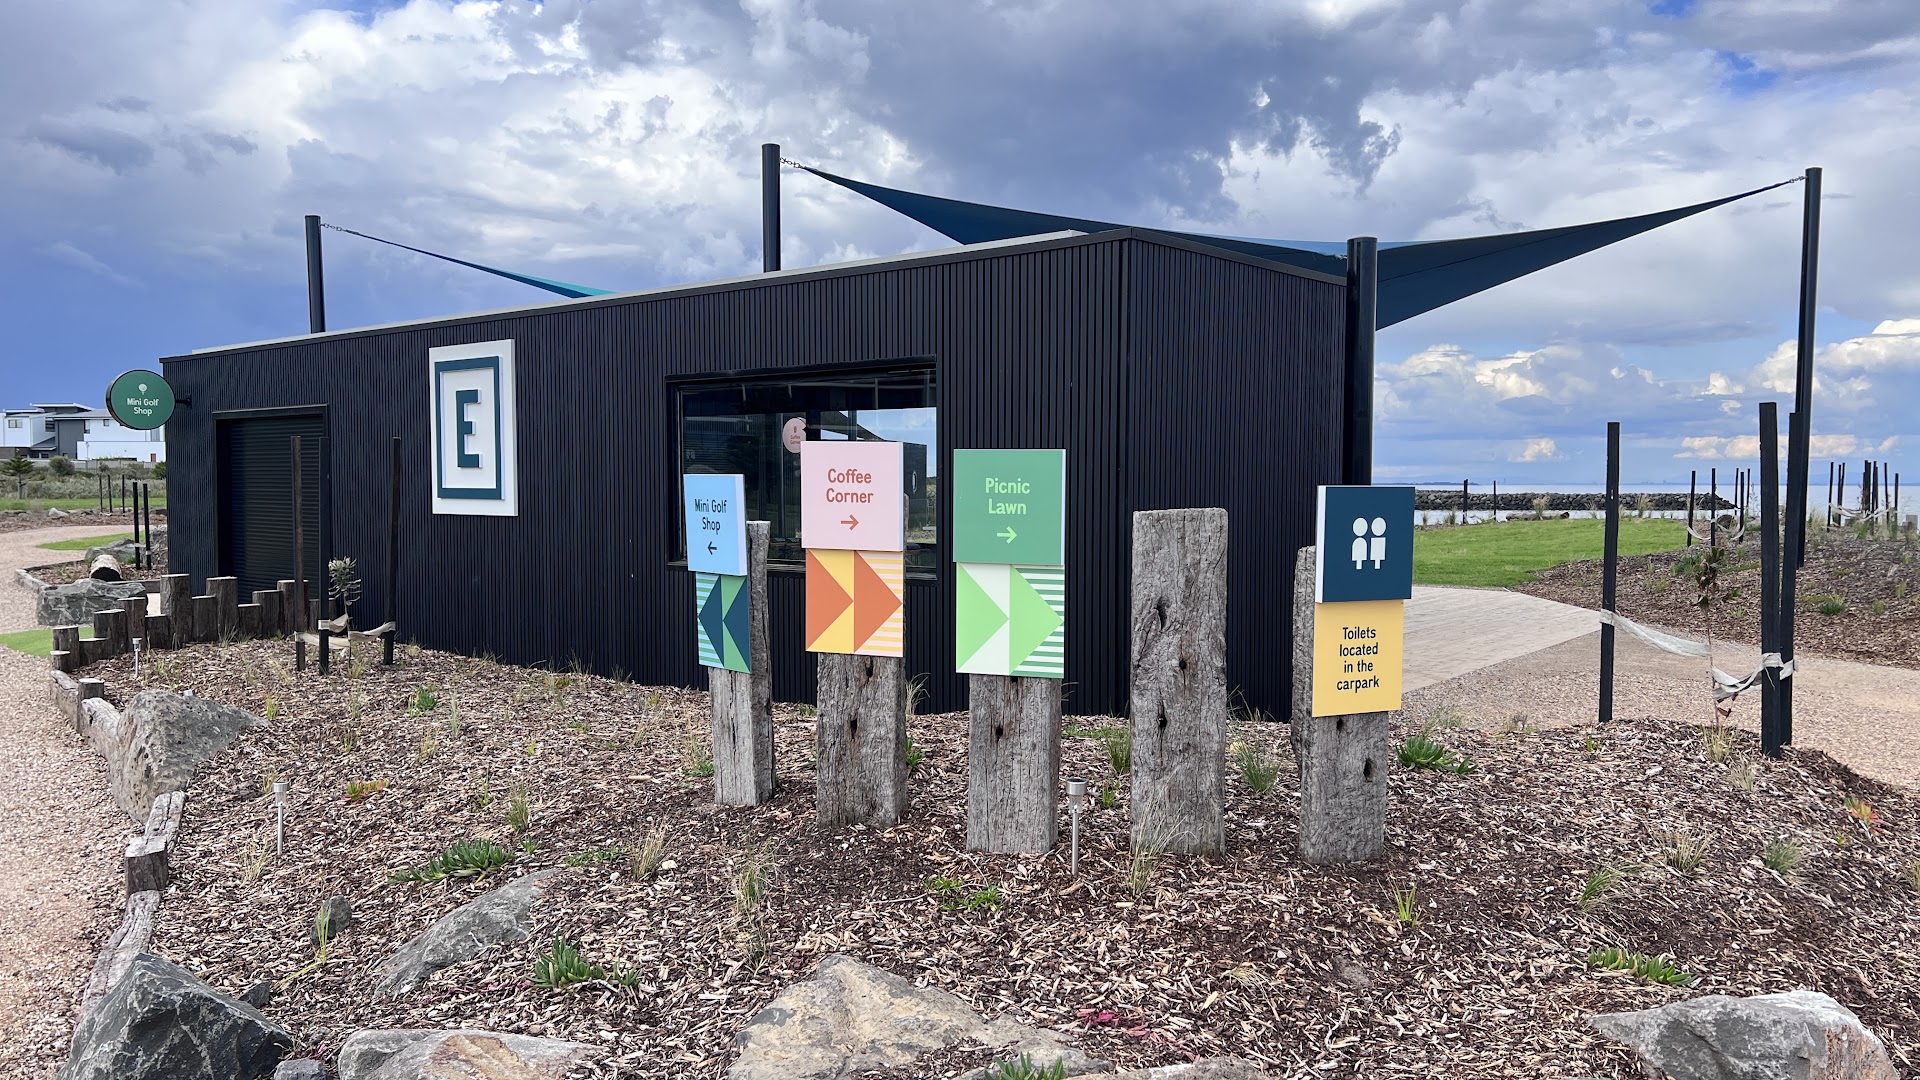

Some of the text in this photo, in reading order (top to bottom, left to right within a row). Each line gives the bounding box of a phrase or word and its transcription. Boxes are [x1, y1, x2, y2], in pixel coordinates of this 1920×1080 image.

[127, 398, 159, 406] Mini Golf
[134, 407, 152, 416] Shop
[456, 389, 481, 468] E
[828, 468, 872, 483] Coffee
[985, 477, 1030, 494] Picnic
[826, 487, 873, 503] Corner
[695, 499, 727, 513] Mini Golf
[988, 498, 1026, 514] Lawn
[702, 516, 720, 535] Shop
[1342, 626, 1376, 640] Toilets
[1339, 642, 1378, 656] located
[1344, 660, 1373, 673] in the
[1336, 676, 1379, 693] carpark
